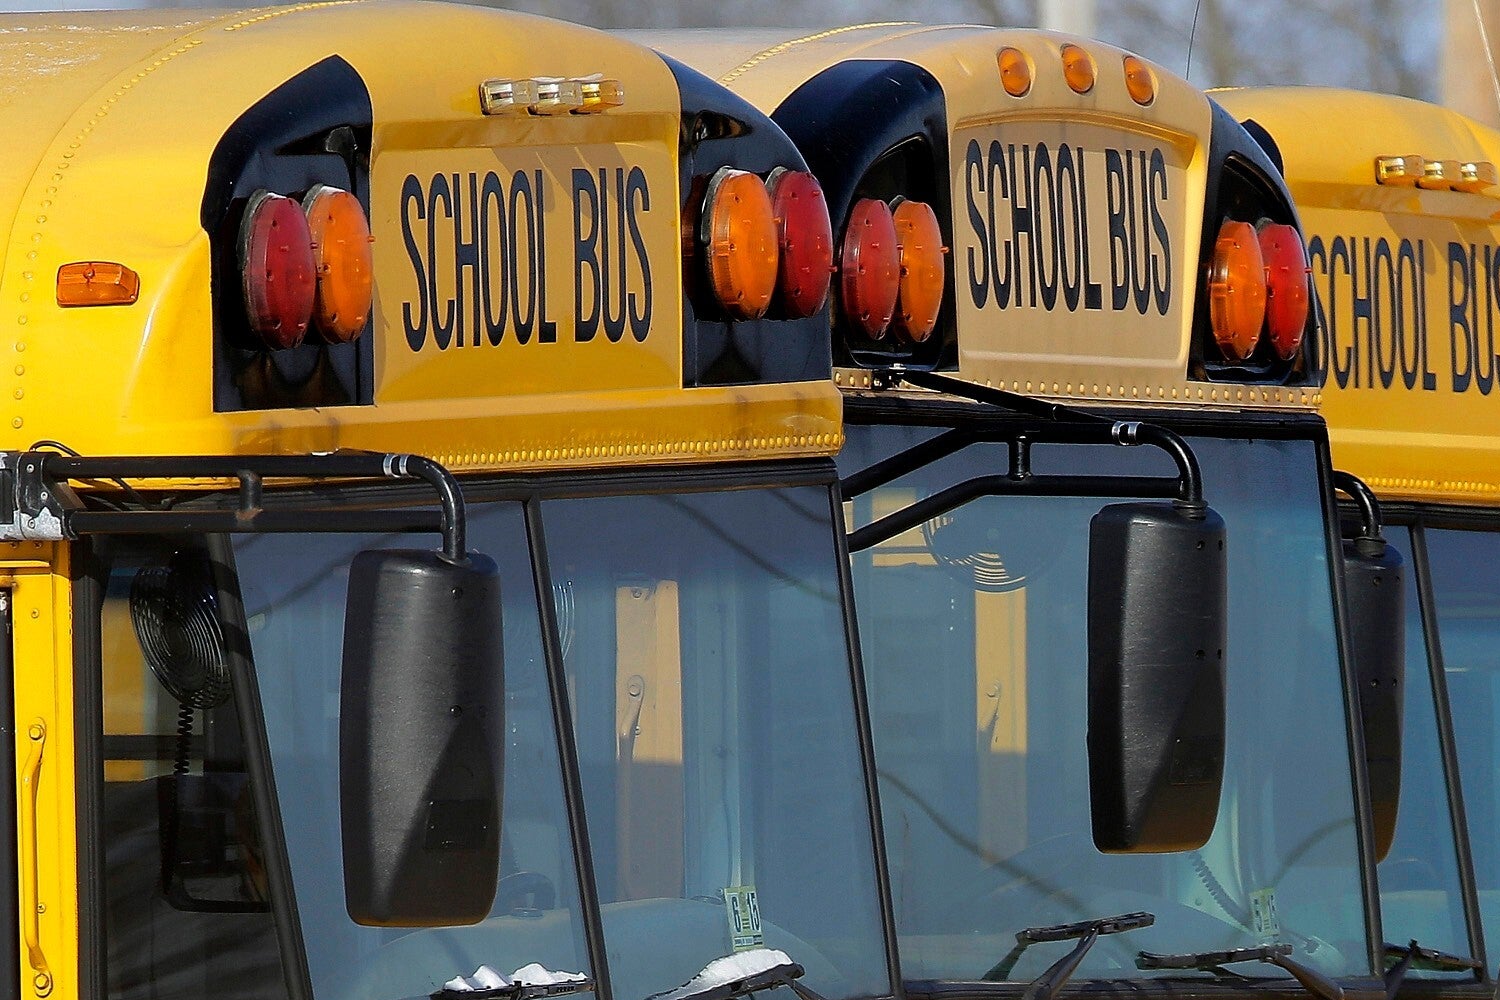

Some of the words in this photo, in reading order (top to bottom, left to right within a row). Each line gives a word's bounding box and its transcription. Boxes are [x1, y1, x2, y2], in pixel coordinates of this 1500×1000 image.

[400, 167, 557, 353] SCHOOL
[571, 165, 653, 345] BUS
[965, 138, 1103, 313] SCHOOL
[1104, 147, 1172, 317] BUS
[1308, 234, 1438, 391] SCHOOL
